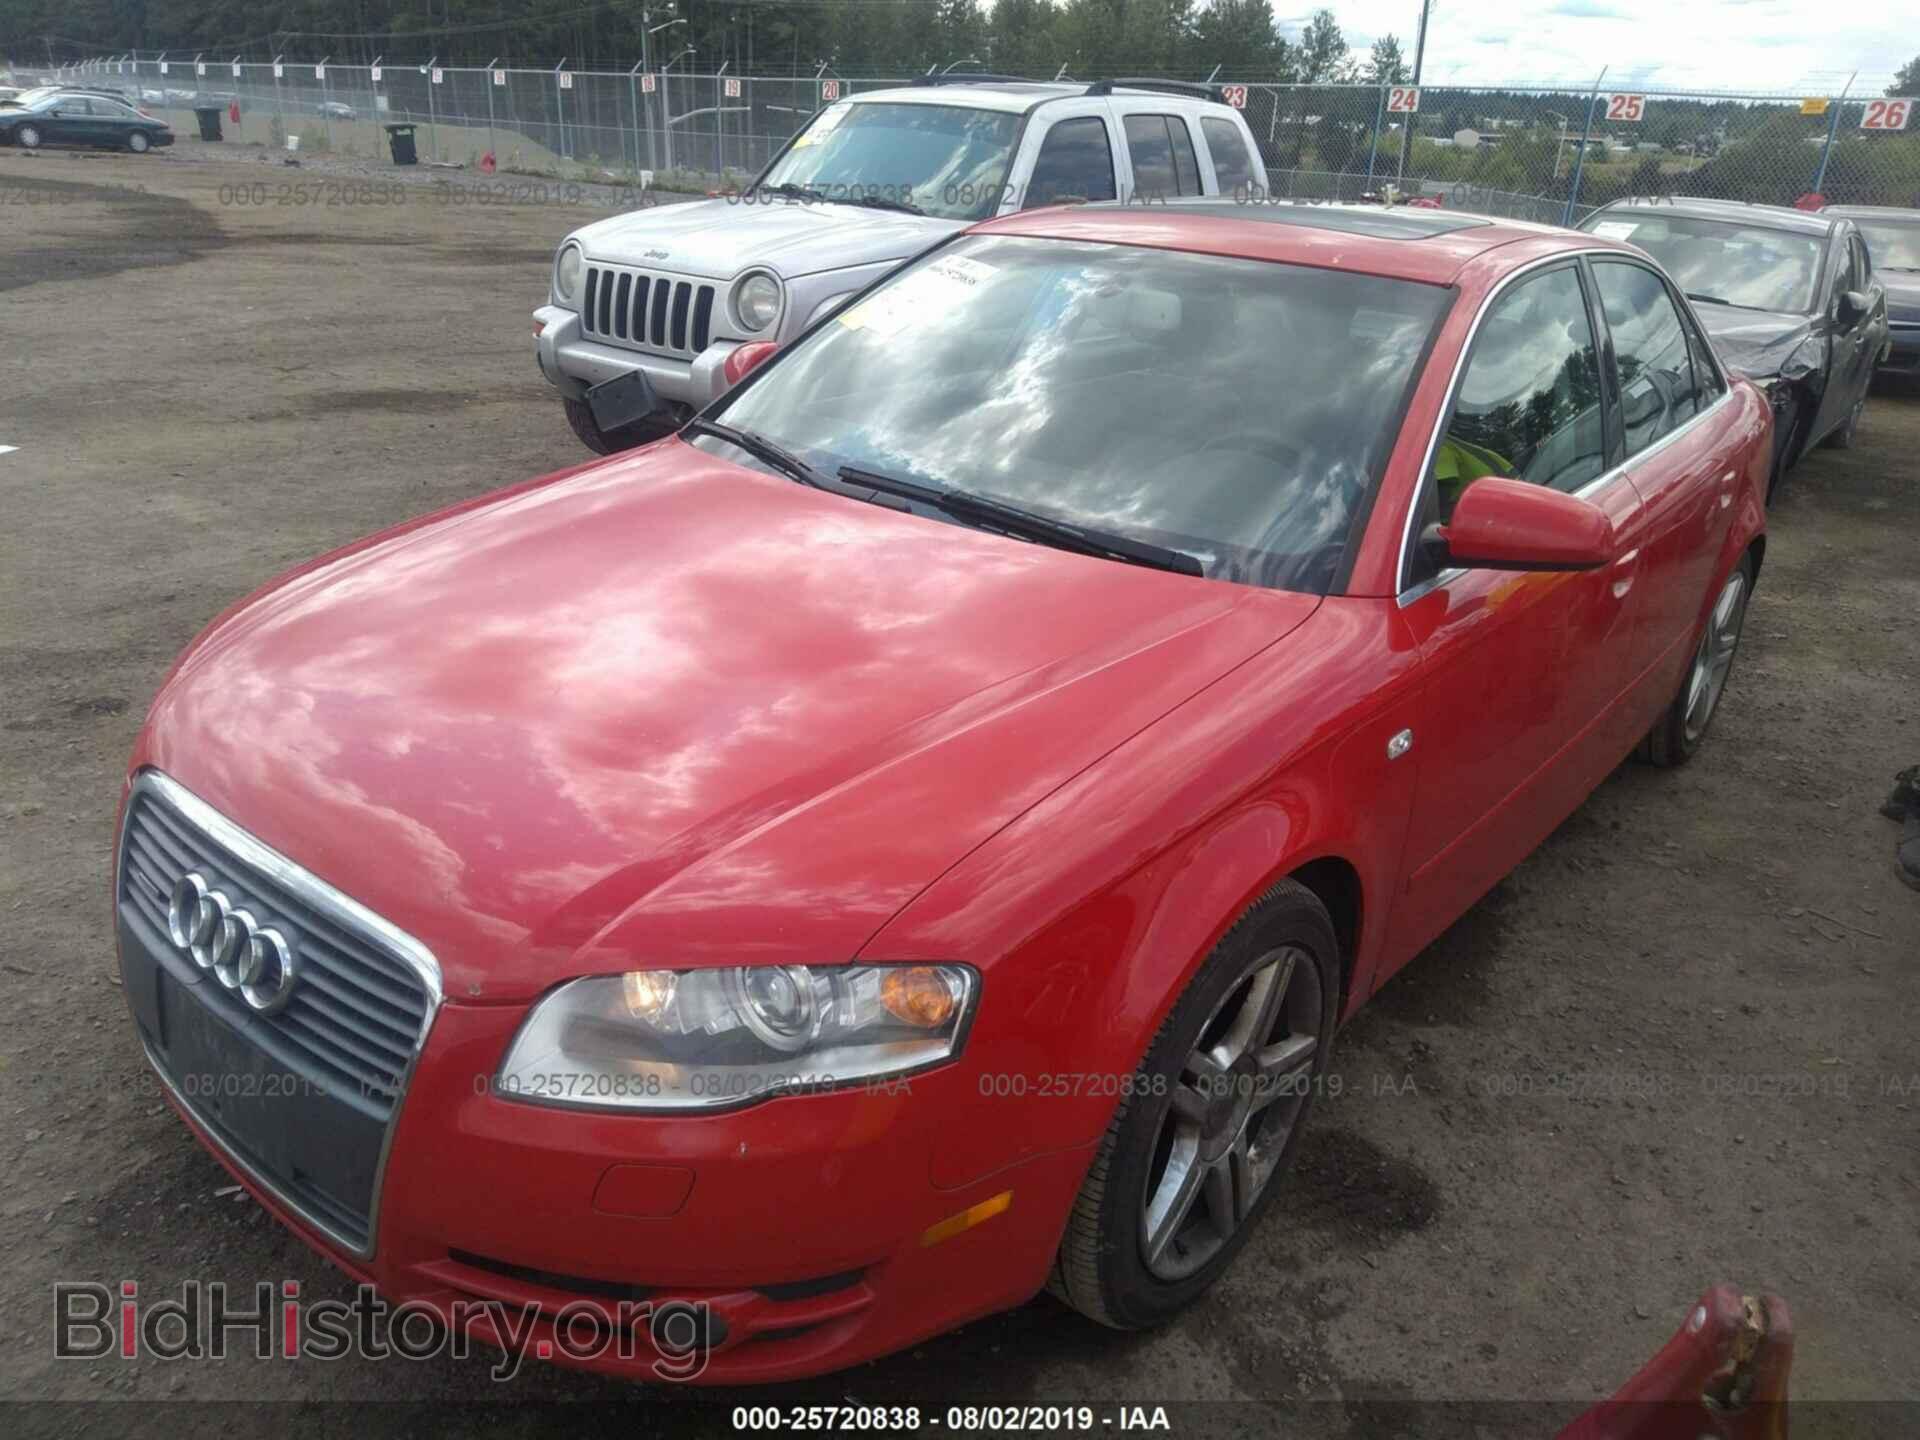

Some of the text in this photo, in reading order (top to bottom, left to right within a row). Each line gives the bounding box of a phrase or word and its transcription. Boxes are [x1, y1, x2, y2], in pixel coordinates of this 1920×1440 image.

[729, 80, 738, 95] 19
[824, 82, 838, 98] 20
[1224, 87, 1244, 107] 23
[1391, 88, 1416, 110] 24
[1609, 95, 1642, 118] 25
[1864, 101, 1905, 128] 26
